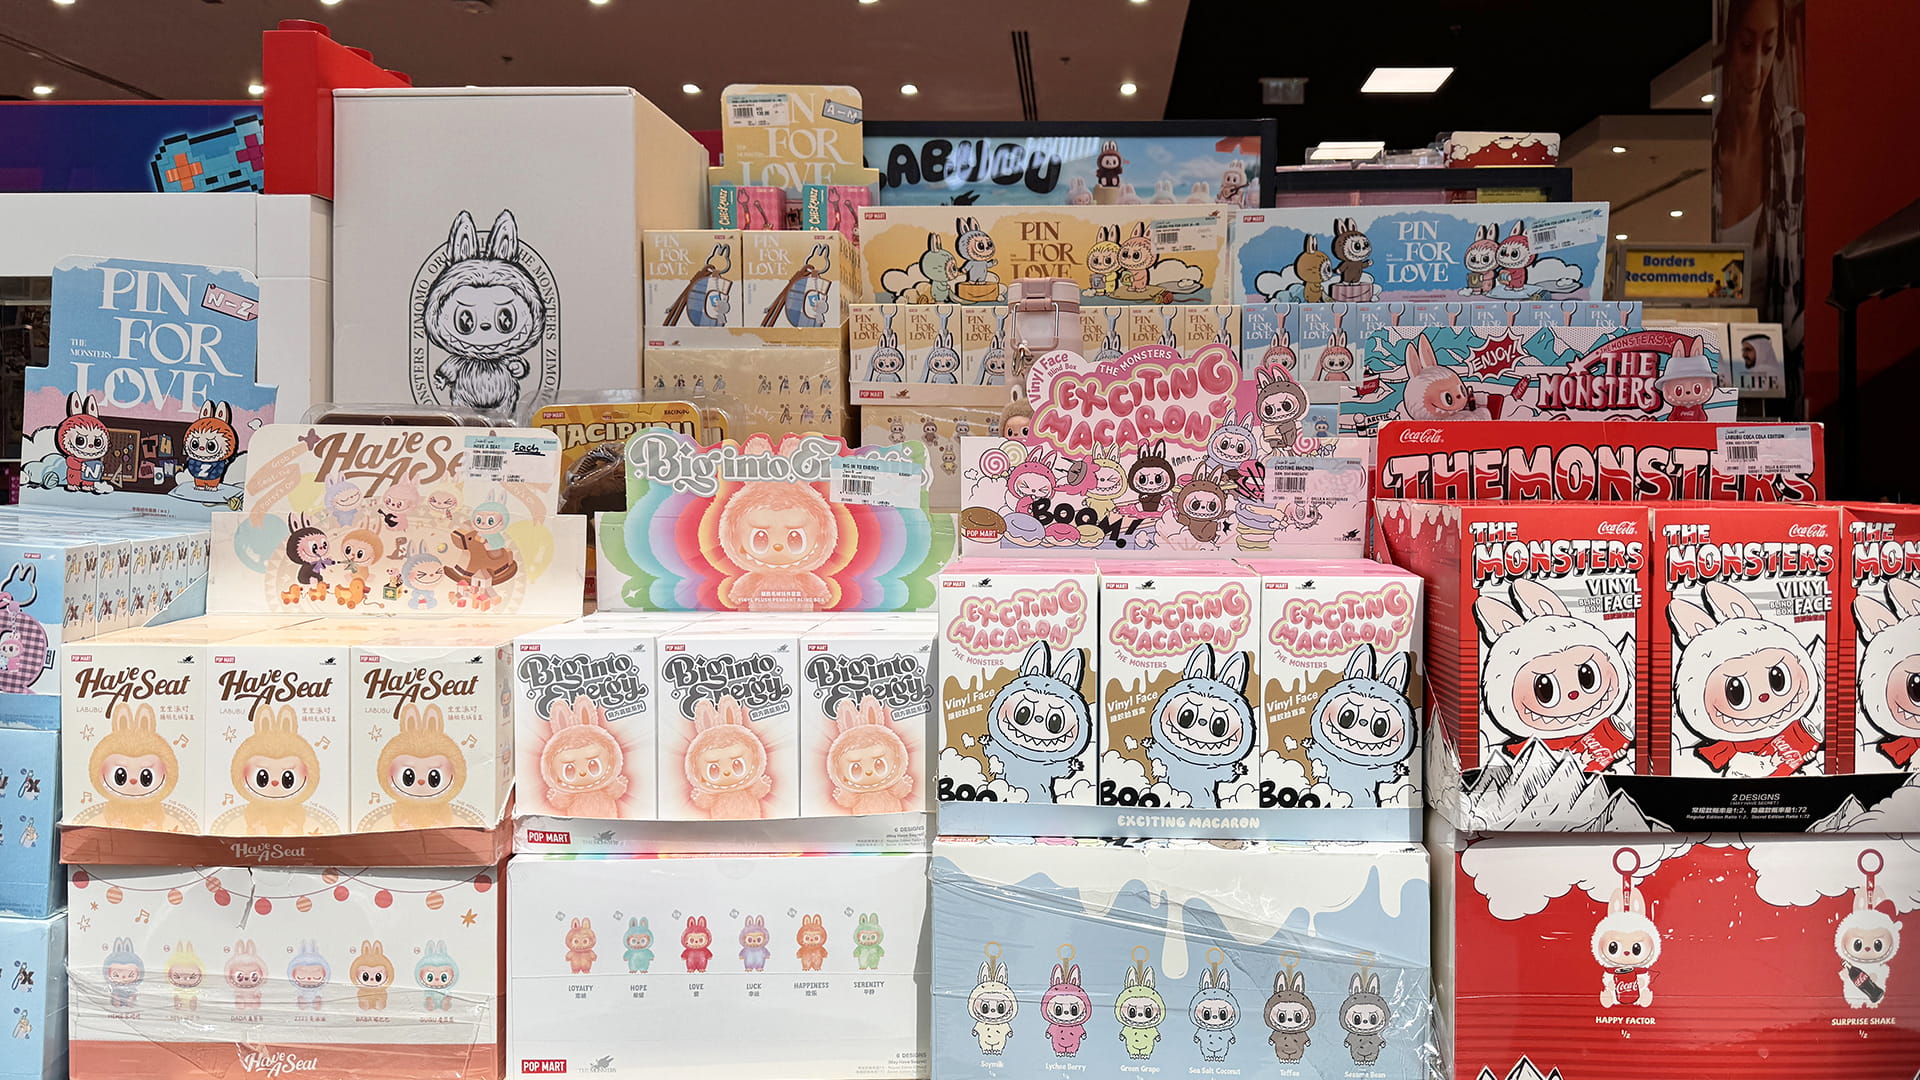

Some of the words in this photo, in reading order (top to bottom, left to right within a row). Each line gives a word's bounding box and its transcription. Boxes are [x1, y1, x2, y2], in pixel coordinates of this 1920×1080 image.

[766, 127, 857, 165] FOR
[738, 161, 836, 192] LOVE
[1014, 221, 1061, 240] PIN
[1392, 220, 1440, 240] PIN
[655, 235, 680, 247] PIN
[754, 235, 780, 247] PIN
[660, 248, 695, 264] FOR
[759, 249, 793, 264] FOR
[1028, 242, 1083, 265] FOR
[1404, 241, 1460, 264] FOR
[1643, 255, 1695, 267] Borders
[649, 262, 688, 276] LOVE
[748, 262, 787, 276] LOVE
[1010, 263, 1072, 279] LOVE
[1386, 262, 1449, 283] LOVE
[1625, 272, 1714, 283] Recommends
[98, 266, 197, 316] PIN
[413, 279, 430, 339] ZIMOMO
[853, 332, 878, 341] LOVE
[860, 323, 880, 333] FOR
[1253, 322, 1273, 332] FOR
[70, 338, 88, 348] THE
[113, 316, 244, 378] FOR
[1612, 335, 1664, 350] MONSTERS
[69, 349, 112, 360] MONSTERS
[1100, 363, 1119, 377] THE
[1122, 350, 1172, 372] MONSTERS
[1472, 344, 1518, 371] ENJOY!
[1047, 366, 1063, 378] Blind
[1064, 363, 1077, 372] Box
[1601, 352, 1654, 377] THE
[70, 360, 216, 414] LOVE
[1027, 364, 1044, 404] Vinyl
[1040, 353, 1068, 369] Face
[1058, 352, 1234, 418] EXCITING
[1740, 376, 1779, 389] LIFE
[1538, 373, 1659, 410] MONSTERS
[1038, 403, 1212, 451] MACARON
[1367, 413, 1390, 423] ARCTIC
[511, 442, 540, 453] Each
[313, 431, 424, 484] Have
[629, 433, 722, 497] Big
[722, 444, 788, 481] into
[965, 530, 981, 538] POP
[981, 530, 998, 538] MART
[1470, 522, 1518, 544] THE
[1664, 524, 1711, 546] THE
[1850, 522, 1896, 543] THE
[1474, 540, 1645, 585] MONSTERS
[1667, 543, 1835, 588] MONSTERS
[1585, 578, 1642, 597] VINYL
[1777, 580, 1833, 598] VINYL
[967, 586, 1081, 627] EXCITING
[1129, 588, 1246, 630] EXCITING
[1290, 588, 1408, 631] EXCITING
[1578, 598, 1601, 607] BLIND
[1602, 594, 1642, 612] FACE
[1585, 605, 1602, 613] BOX
[1769, 600, 1792, 609] BLIND
[1794, 597, 1833, 615] FACE
[1776, 608, 1792, 616] BOX
[952, 618, 1068, 650] MACARON
[1116, 620, 1232, 651] MACARON
[1275, 622, 1394, 652] MACARON
[951, 647, 965, 662] THE
[966, 658, 1004, 666] MONSTERS
[1114, 649, 1128, 664] THE
[1129, 660, 1167, 668] MONSTERS
[517, 654, 590, 689] Big
[582, 654, 632, 678] into
[662, 654, 735, 689] Big
[727, 654, 776, 678] into
[804, 654, 877, 689] Big
[868, 654, 918, 678] into
[75, 667, 139, 699] Have
[218, 669, 282, 702] Have
[275, 671, 333, 703] Seat
[363, 668, 427, 699] Have
[420, 669, 479, 701] Seat
[91, 683, 131, 719] A
[132, 669, 191, 700] Seat
[945, 692, 971, 711] Vinyl
[973, 688, 996, 701] Face
[1107, 694, 1133, 713] Vinyl
[1135, 690, 1158, 704] Face
[1266, 694, 1293, 714] Vinyl
[1295, 690, 1319, 704] Face
[76, 706, 103, 714] LABUBU
[219, 707, 246, 715] LABUBU
[1117, 815, 1185, 829] EXCITING
[1188, 815, 1261, 829] MACARON
[529, 832, 546, 842] POP
[546, 832, 570, 843] MART
[230, 843, 271, 858] Have
[270, 844, 306, 859] Seat
[1595, 1015, 1624, 1025] HAPPY
[1625, 1016, 1657, 1025] FACTOR
[1831, 1017, 1869, 1026] SURPRISE
[1869, 1017, 1896, 1025] SHAKE
[244, 1052, 286, 1073] Have
[282, 1053, 318, 1073] Seat
[523, 1061, 541, 1071] POP
[542, 1060, 566, 1071] MART
[980, 1060, 1004, 1070] Soymilk
[1045, 1062, 1066, 1072] Lychee
[1067, 1063, 1087, 1072] Berry
[1120, 1064, 1139, 1073] Green
[1139, 1064, 1160, 1074] Grape
[1188, 1066, 1201, 1074] Sea
[1201, 1066, 1214, 1075] Salt
[1215, 1067, 1241, 1075] Coconut
[1279, 1068, 1300, 1077] Toffee
[1368, 1070, 1386, 1079] Bean
